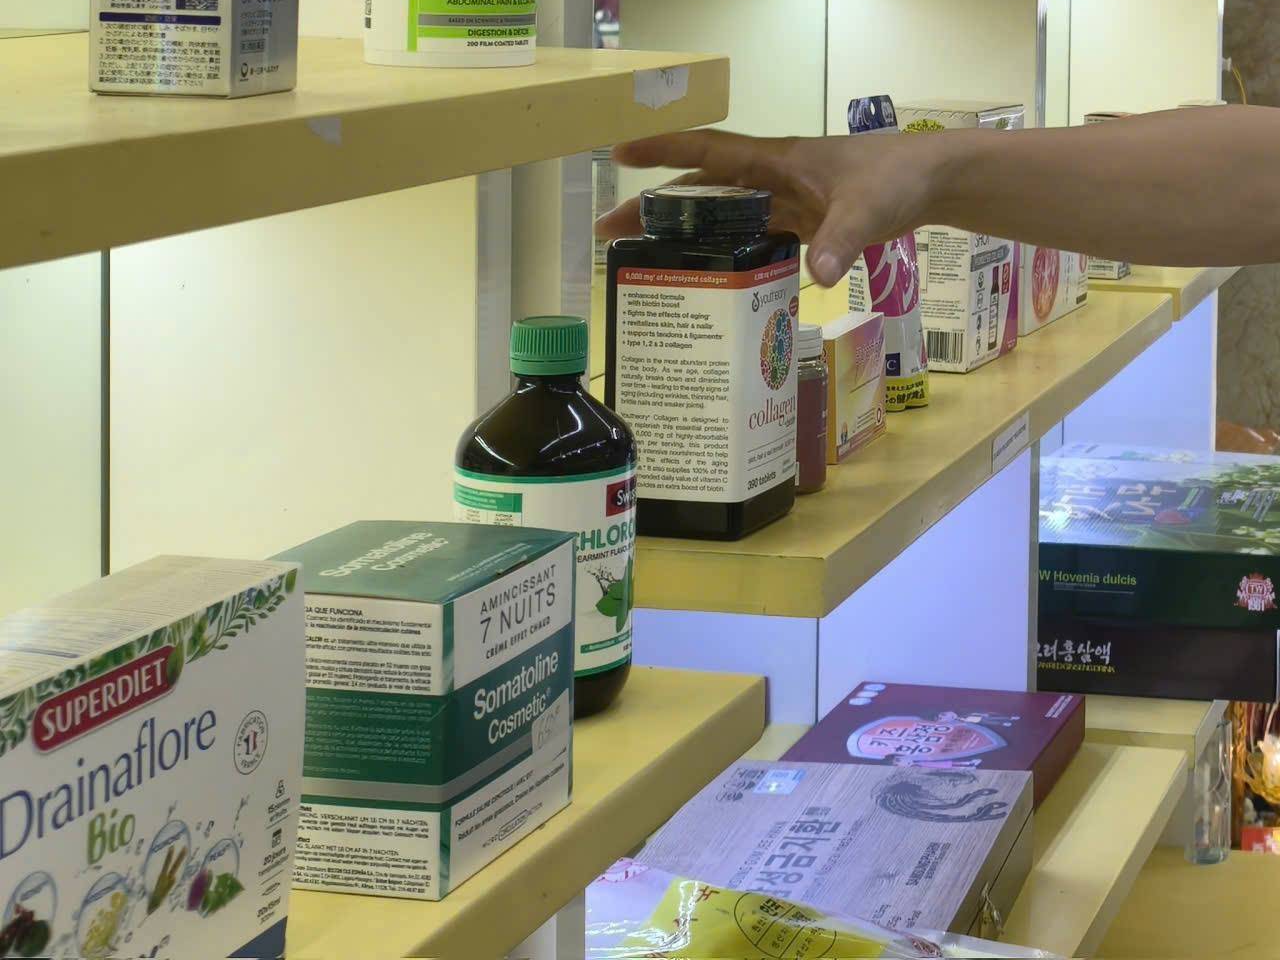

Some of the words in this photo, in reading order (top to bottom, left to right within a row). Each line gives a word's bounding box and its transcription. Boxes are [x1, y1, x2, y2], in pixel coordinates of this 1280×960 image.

[468, 28, 507, 38] DIGESTION
[627, 310, 645, 318] fights
[646, 310, 657, 318] the
[658, 311, 681, 319] effects
[660, 293, 685, 301] formula
[627, 320, 659, 328] revitalizes
[627, 330, 656, 338] supports
[656, 331, 683, 339] tendons
[480, 564, 557, 616] AMINCISSANT
[1053, 570, 1100, 584] Hovenia
[1102, 573, 1137, 586] dulcis
[480, 616, 492, 644] 7
[500, 582, 556, 635] NUITS
[41, 657, 165, 741] SUPERDIET
[473, 650, 559, 721] Somatoline
[488, 692, 547, 745] Cosmetic
[0, 709, 217, 861] Drainaflore
[86, 807, 136, 866] Bio
